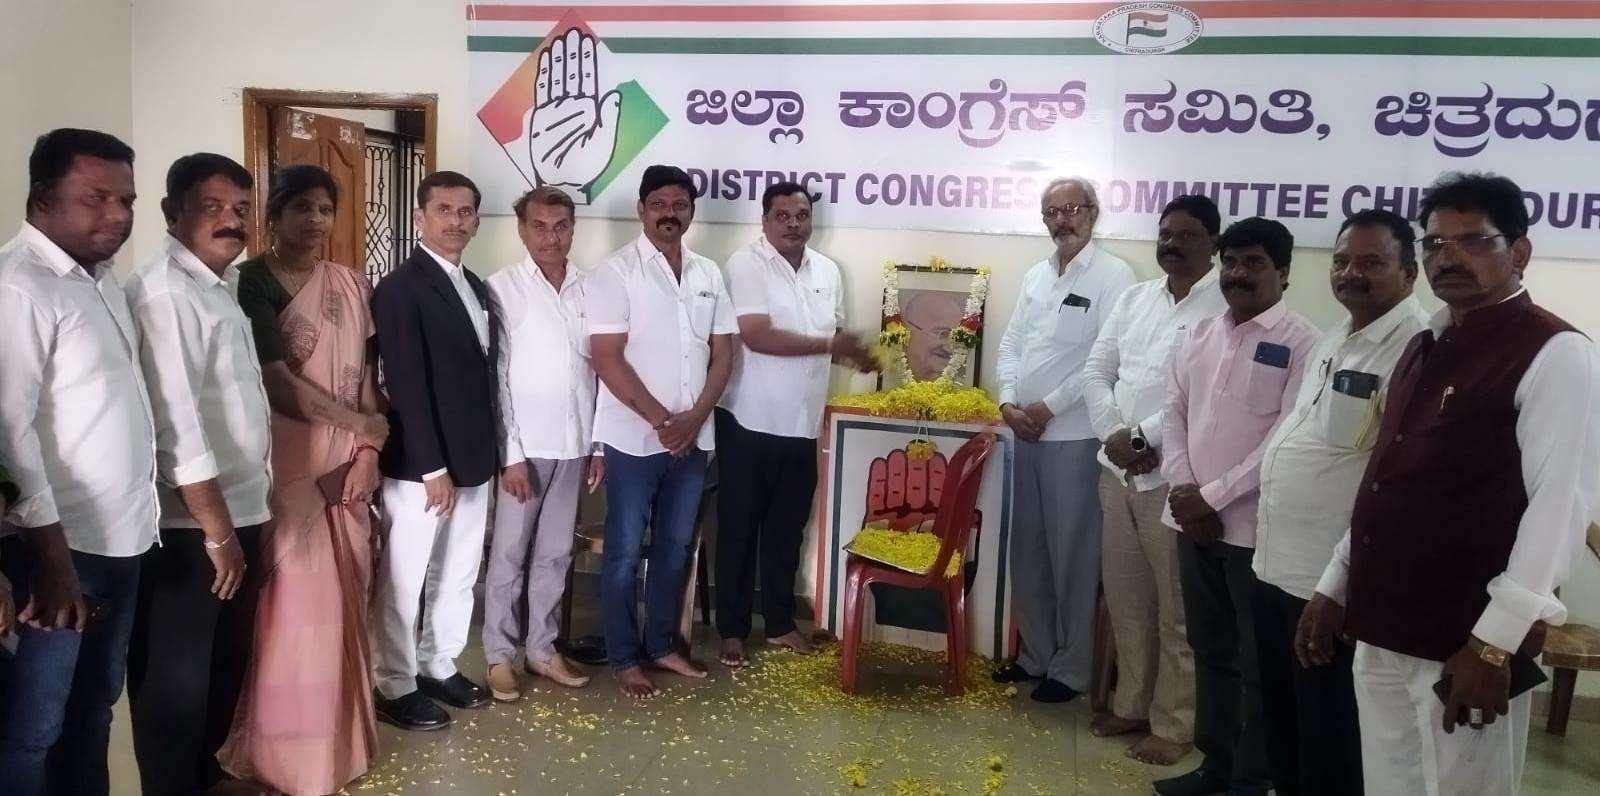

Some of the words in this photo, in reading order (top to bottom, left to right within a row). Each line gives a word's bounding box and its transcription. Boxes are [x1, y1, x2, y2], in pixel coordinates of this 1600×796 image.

[1149, 3, 1184, 13] CONGRESS
[686, 88, 805, 144] ಜಿಲ್ಲಾ
[838, 78, 1087, 149] ಕಾಂಗ್ರೆಸ್
[1122, 79, 1331, 141] ಸಮಿತಿ,
[855, 172, 1039, 209] CONGRES
